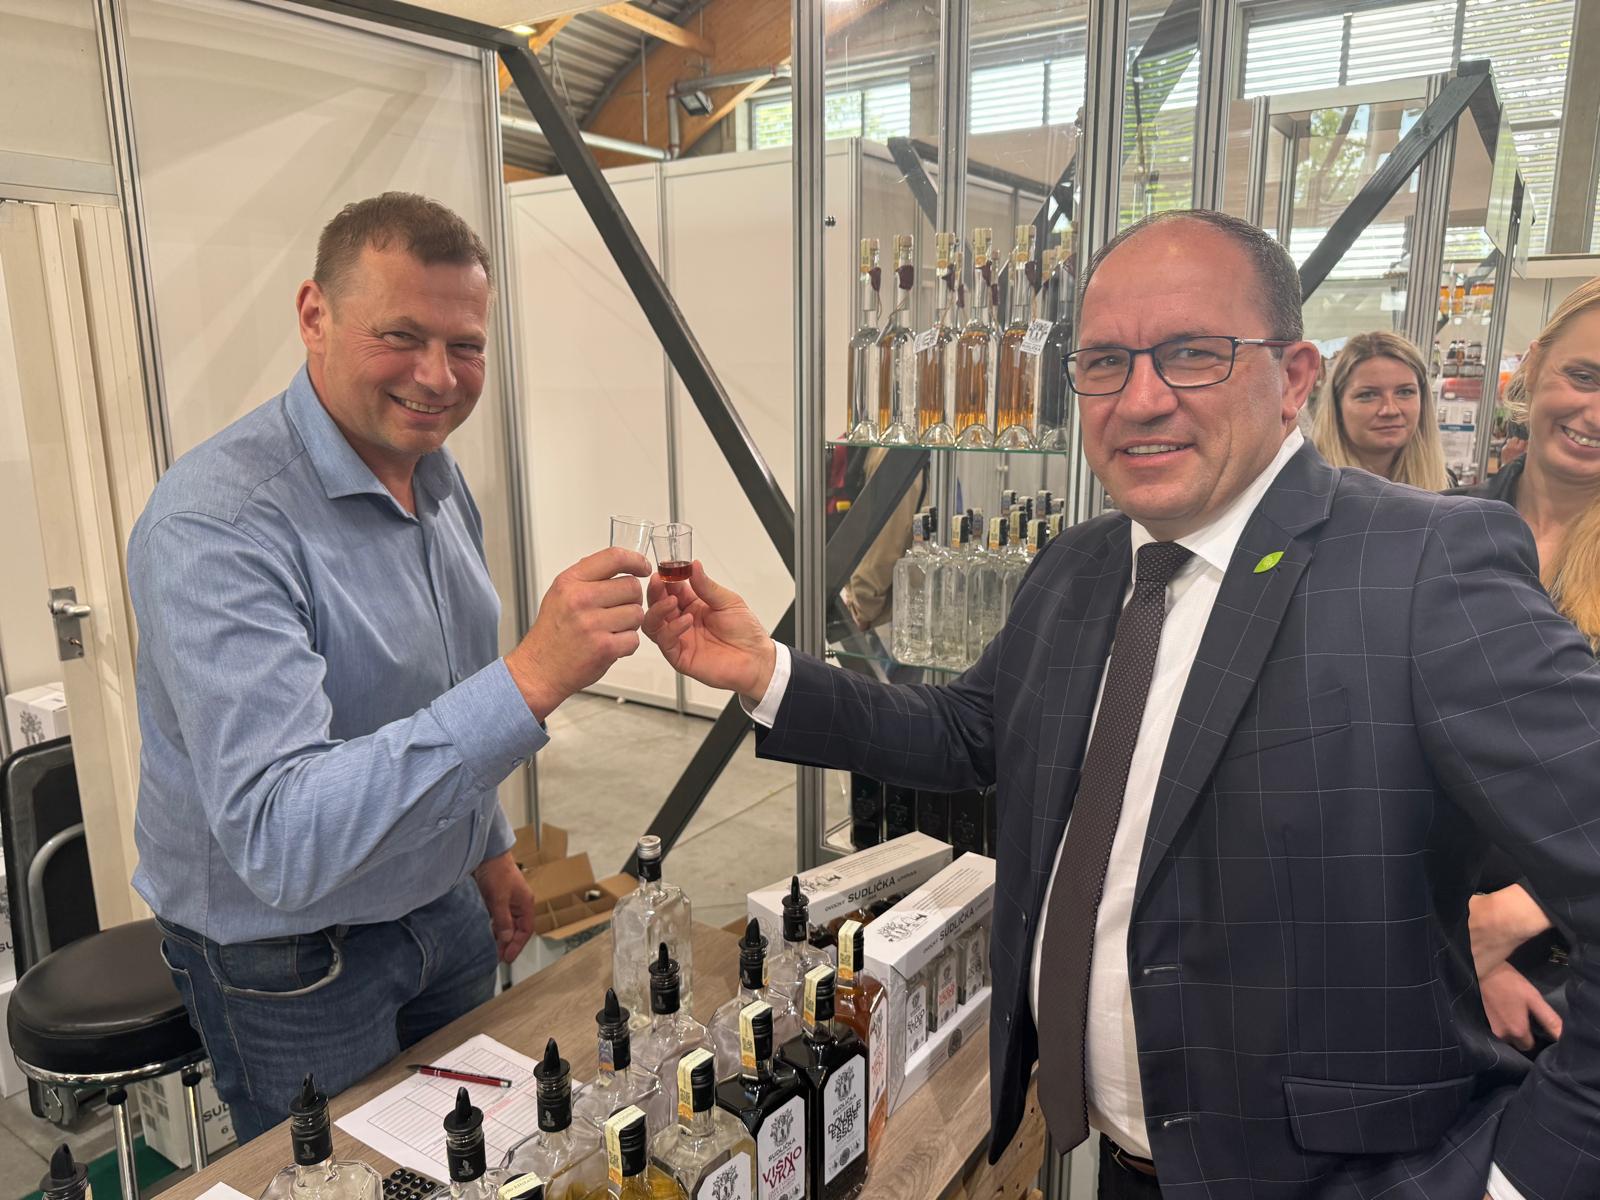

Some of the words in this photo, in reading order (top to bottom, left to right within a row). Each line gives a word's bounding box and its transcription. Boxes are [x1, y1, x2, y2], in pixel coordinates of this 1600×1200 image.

[848, 876, 895, 903] SUDLIČKA
[939, 907, 975, 941] SUDLIČKA
[828, 1099, 861, 1134] DOUBLE
[762, 1146, 802, 1183] VIŠŇO
[769, 1160, 796, 1188] VKA
